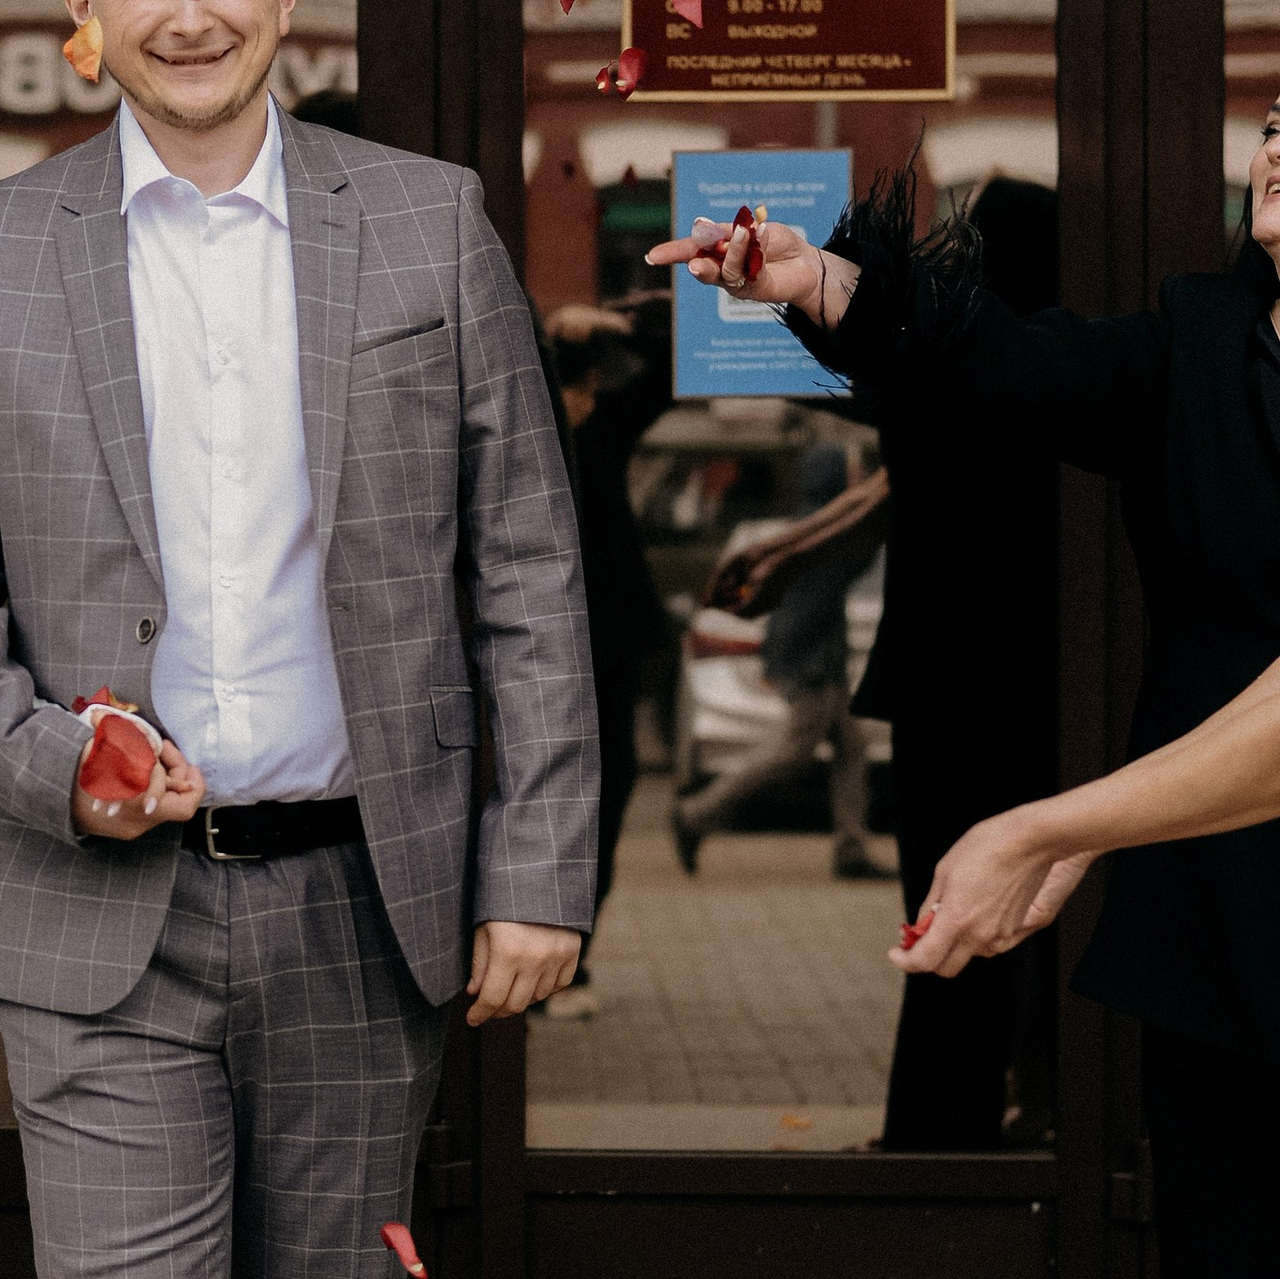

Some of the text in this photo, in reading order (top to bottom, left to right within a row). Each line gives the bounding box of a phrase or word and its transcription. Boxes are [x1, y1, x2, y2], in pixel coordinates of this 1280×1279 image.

[665, 23, 692, 39] ВС
[727, 23, 818, 39] ВЫХОДНОЙ
[764, 55, 833, 70] ЧЕТВЕРГ
[835, 53, 902, 70] МЕСЯЦА
